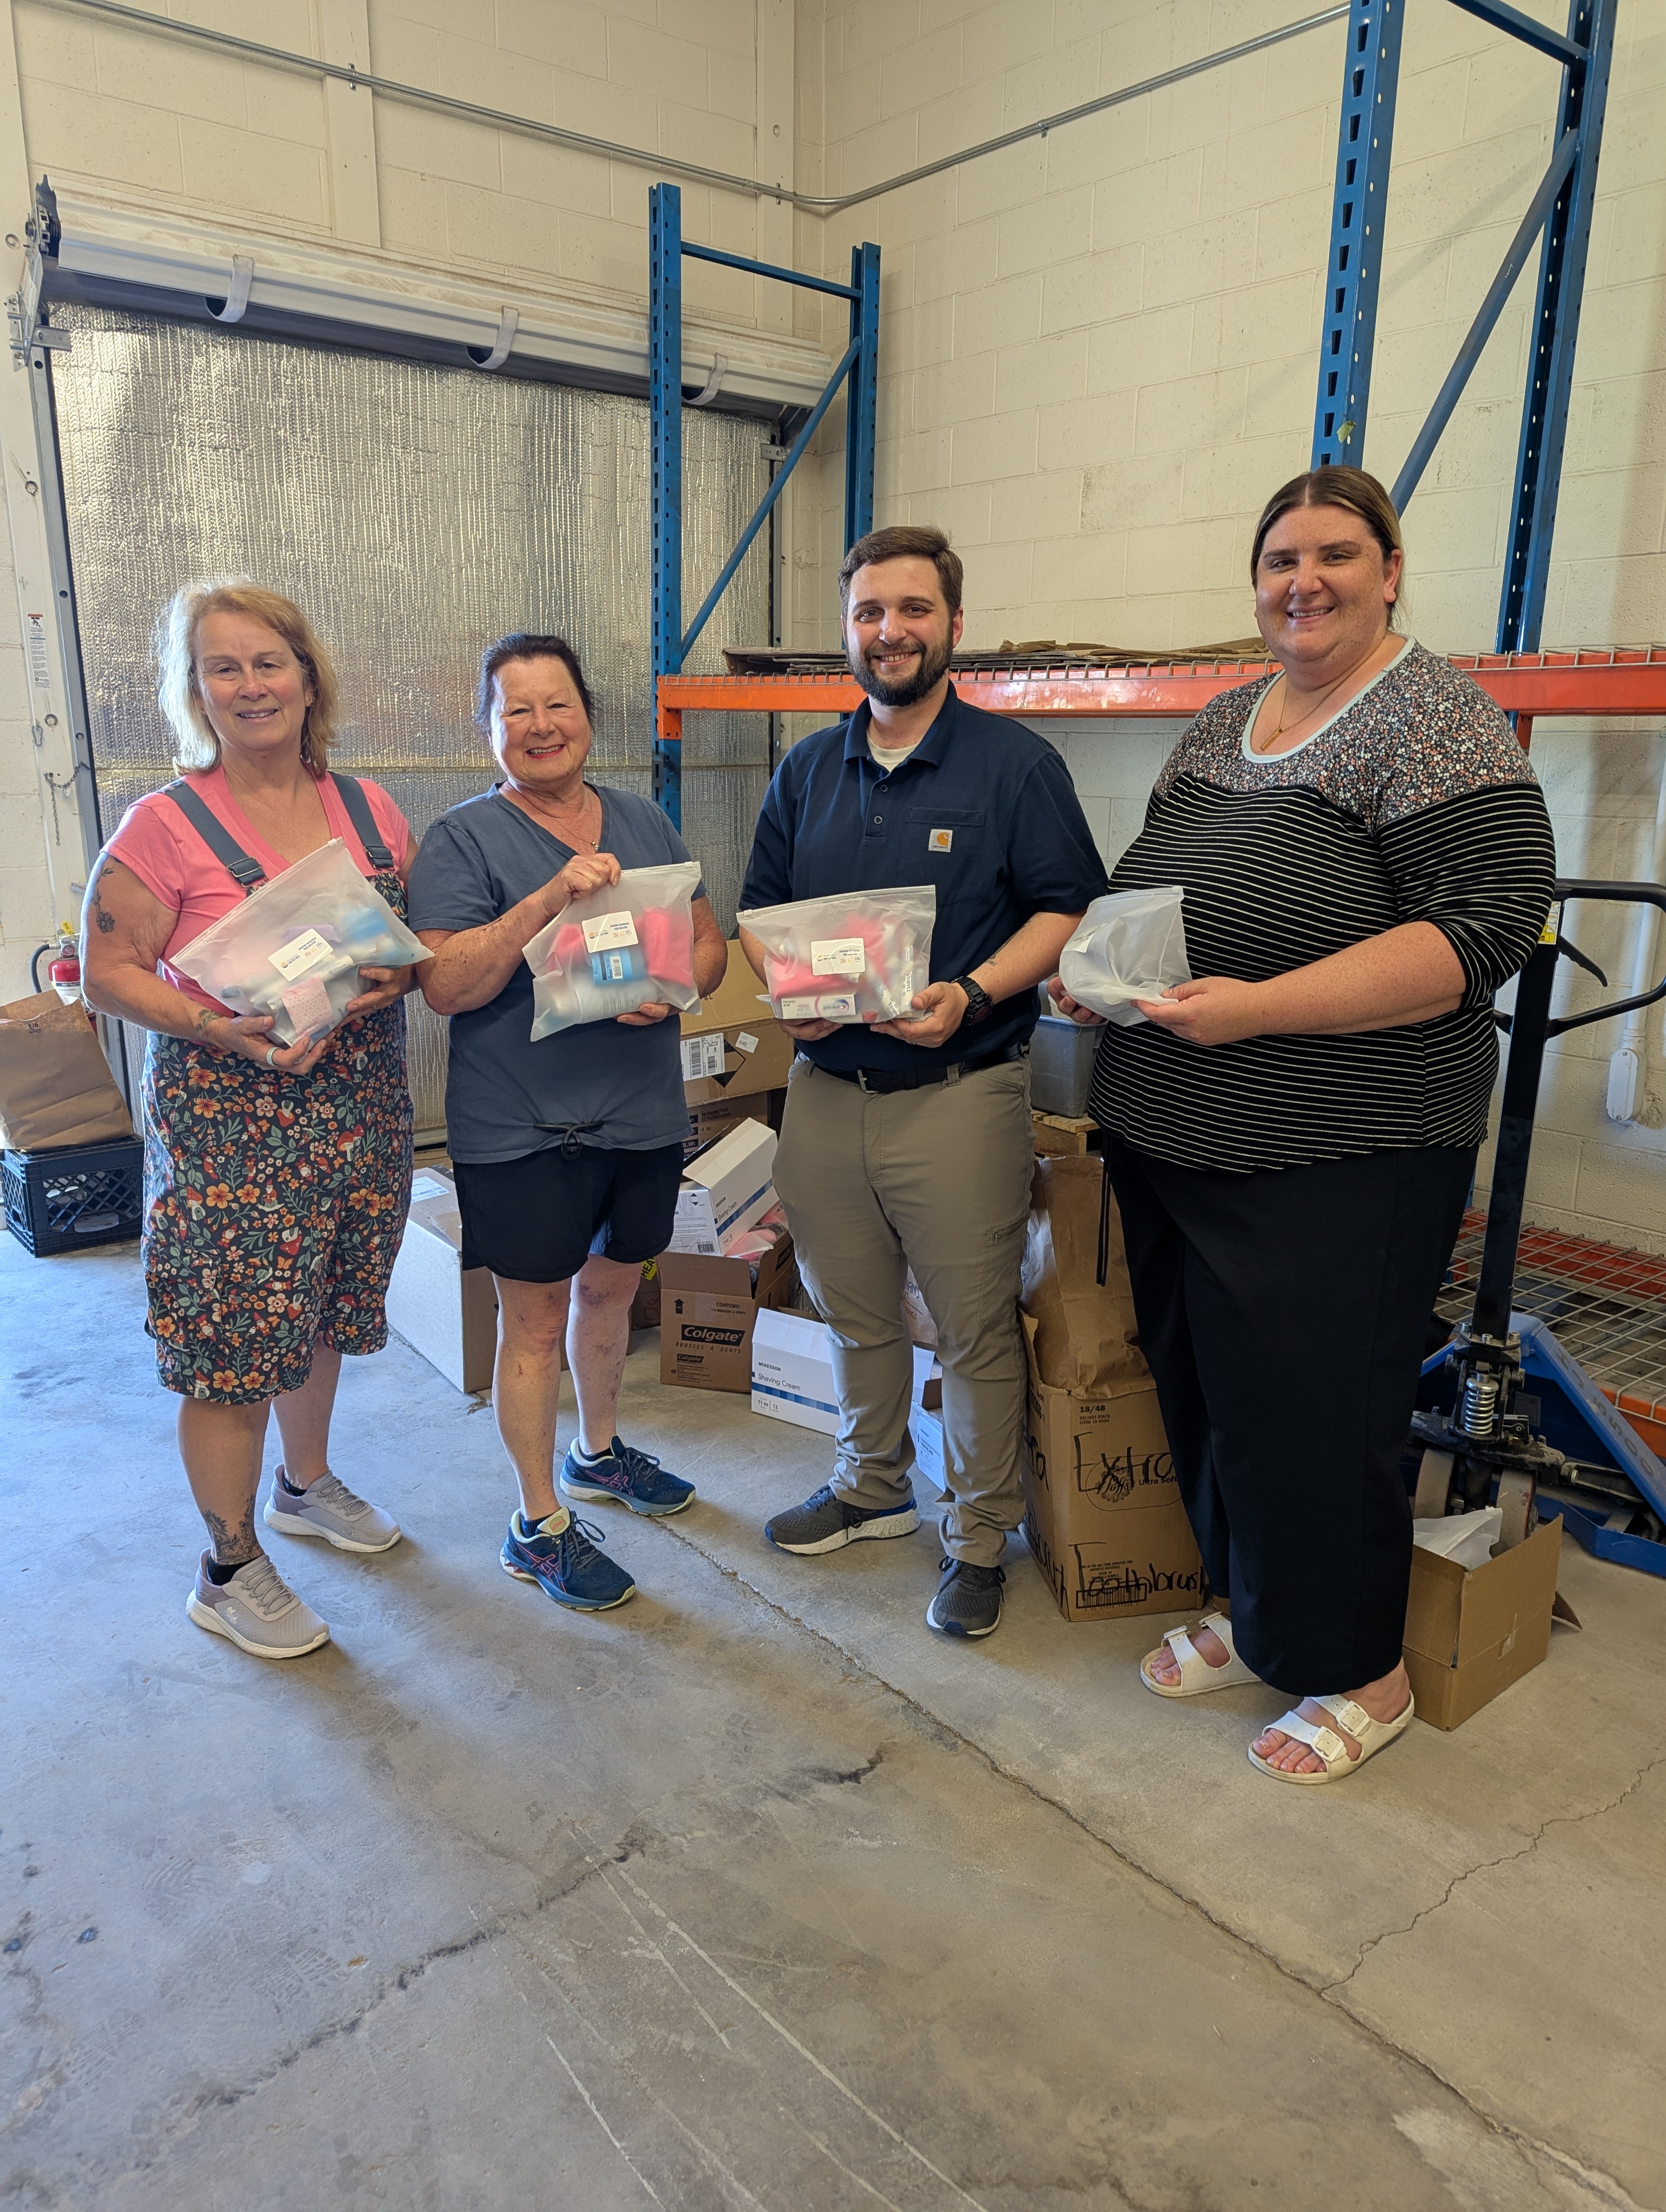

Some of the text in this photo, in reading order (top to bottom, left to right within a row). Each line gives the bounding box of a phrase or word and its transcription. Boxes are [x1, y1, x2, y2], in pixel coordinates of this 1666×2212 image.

[718, 1201, 738, 1221] Shaving Cream
[684, 1327, 739, 1342] Colgate
[758, 1373, 801, 1391] Shaving Cream
[1079, 1405, 1106, 1414] 18/48
[1101, 1475, 1130, 1496] Puffs
[1160, 1475, 1178, 1484] Soft
